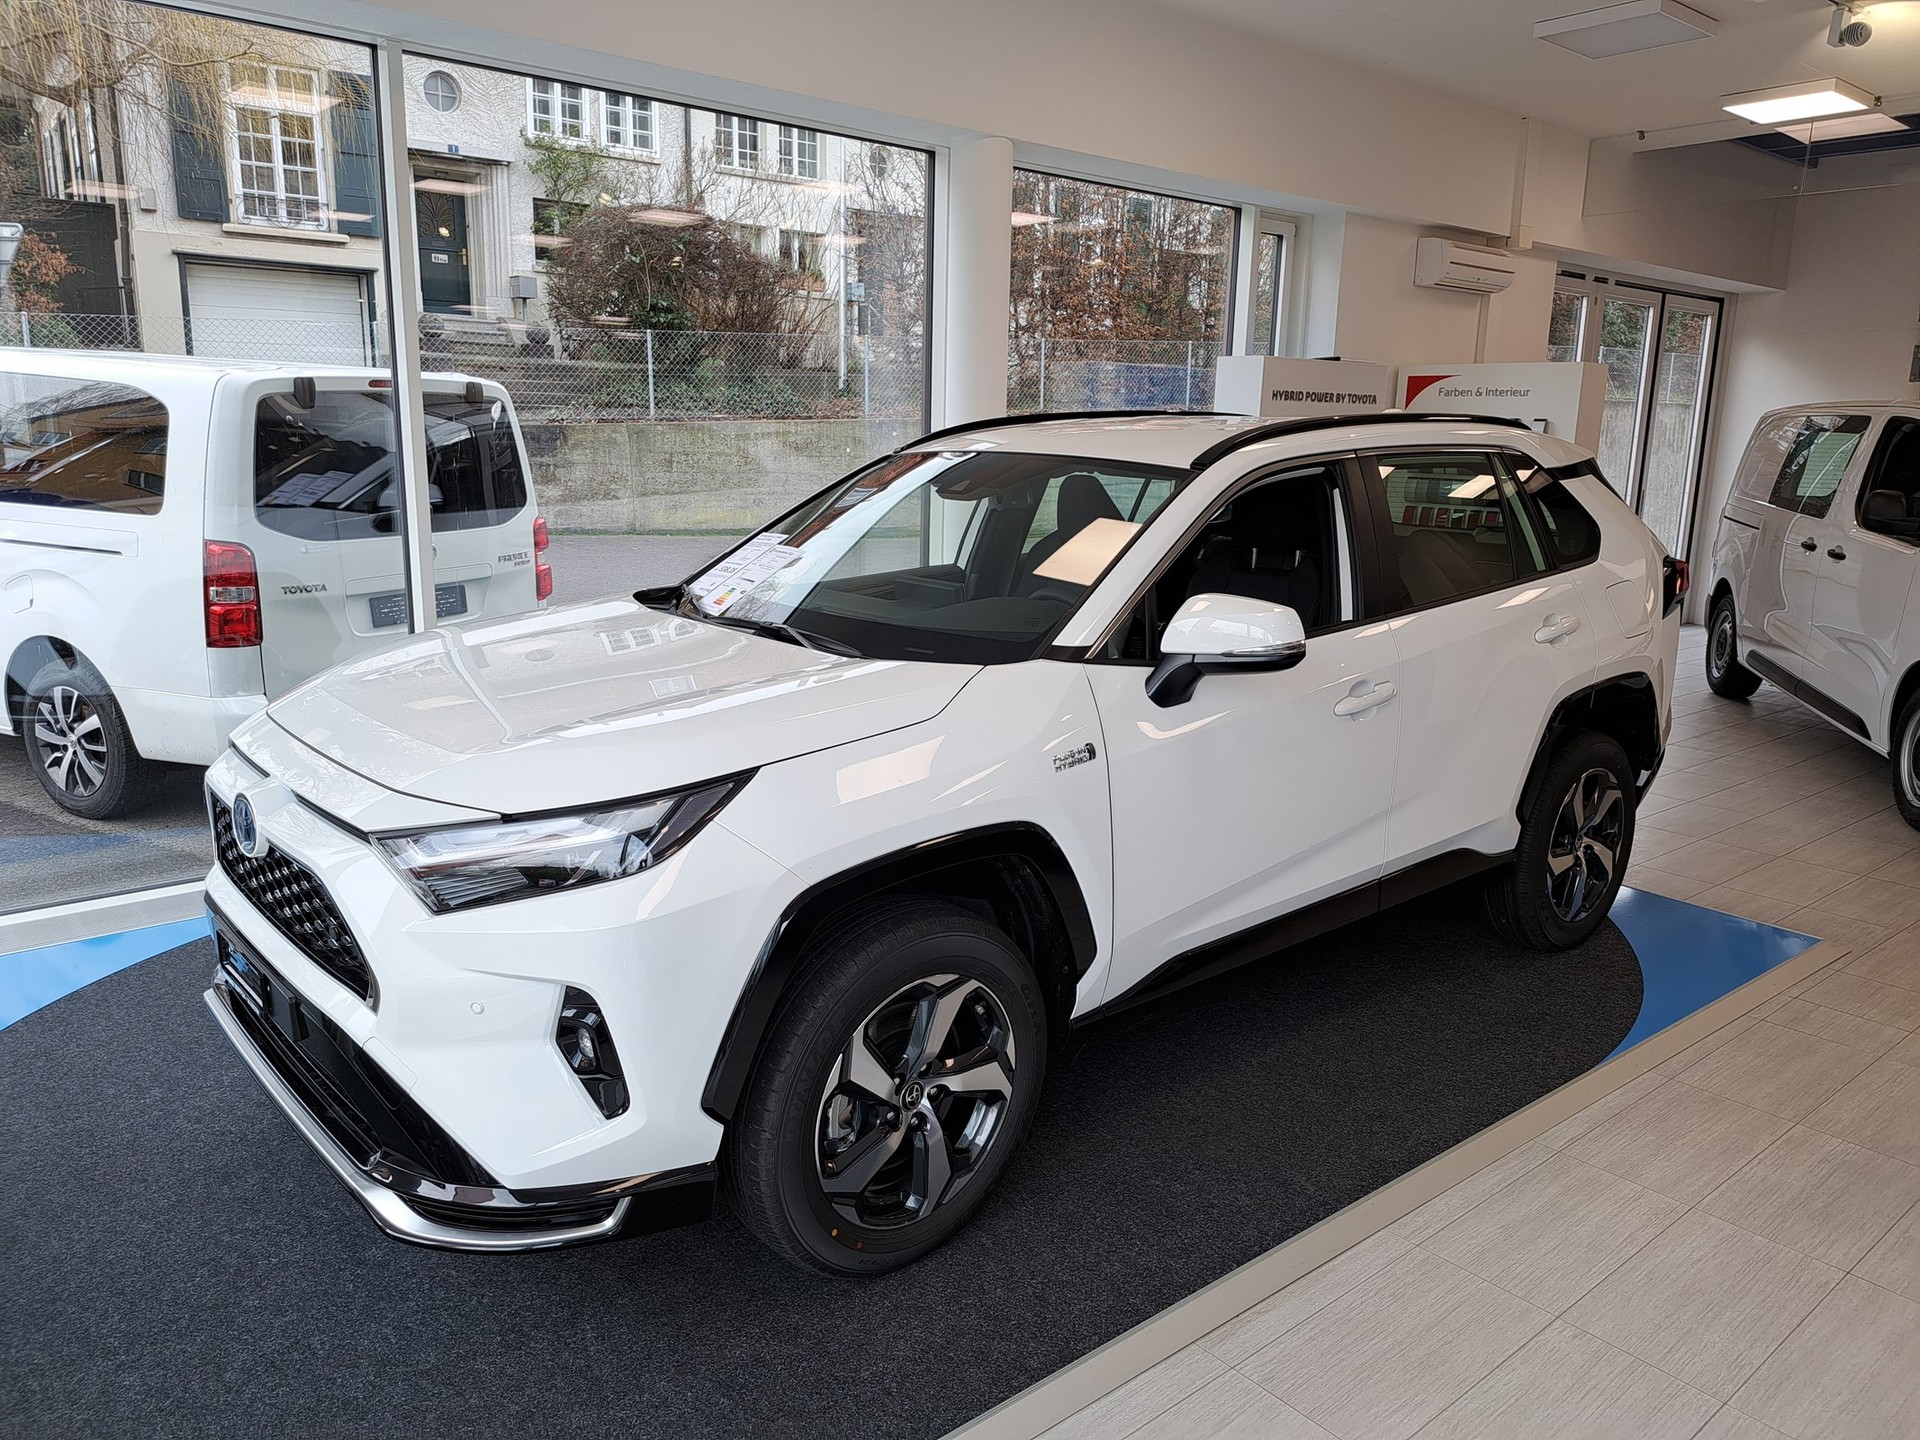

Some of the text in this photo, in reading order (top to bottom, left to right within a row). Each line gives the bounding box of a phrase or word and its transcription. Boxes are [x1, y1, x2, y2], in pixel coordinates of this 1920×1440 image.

[1272, 389, 1377, 405] HYBRID POWER BY TOYOTA
[1438, 387, 1531, 397] Farben & Interieur
[281, 584, 327, 595] TOYOTA
[1052, 746, 1088, 766] PLUG-IN
[1054, 755, 1088, 773] HYBRID
